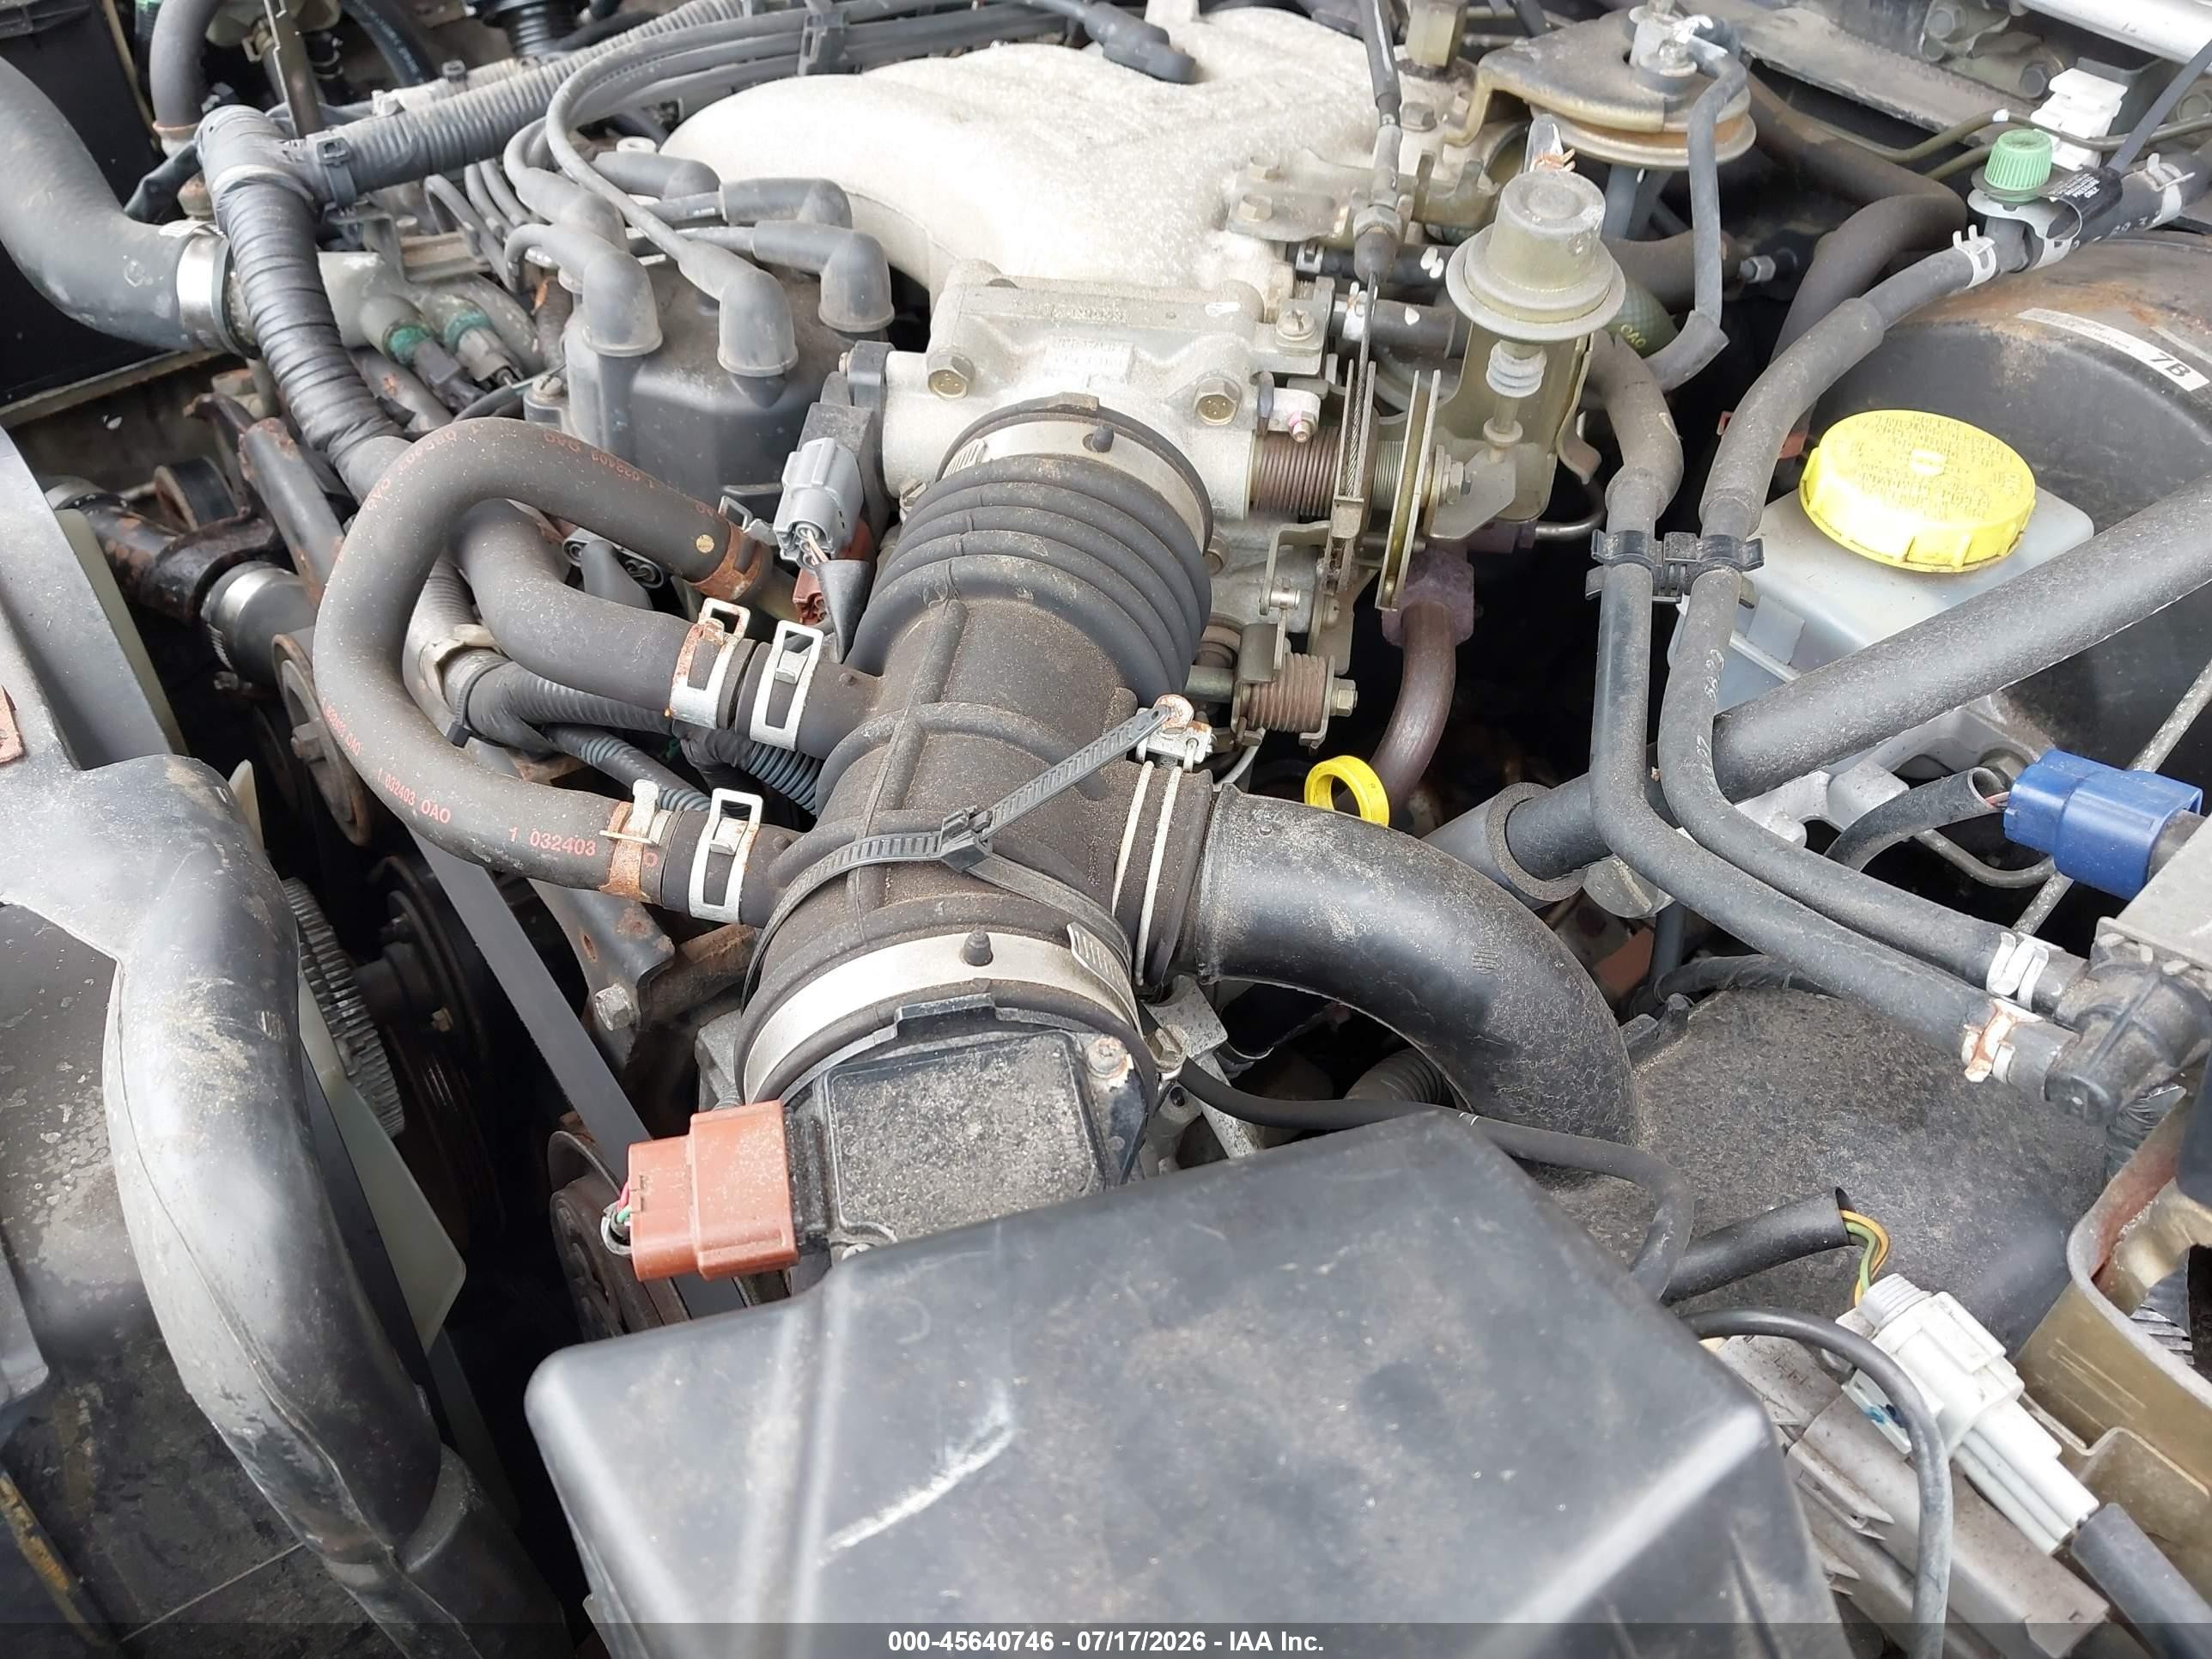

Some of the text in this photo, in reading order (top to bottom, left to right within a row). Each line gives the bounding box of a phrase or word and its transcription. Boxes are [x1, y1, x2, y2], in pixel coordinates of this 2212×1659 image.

[2149, 351, 2191, 377] 7B
[385, 773, 416, 806] 032403
[508, 827, 597, 857] 1 032403
